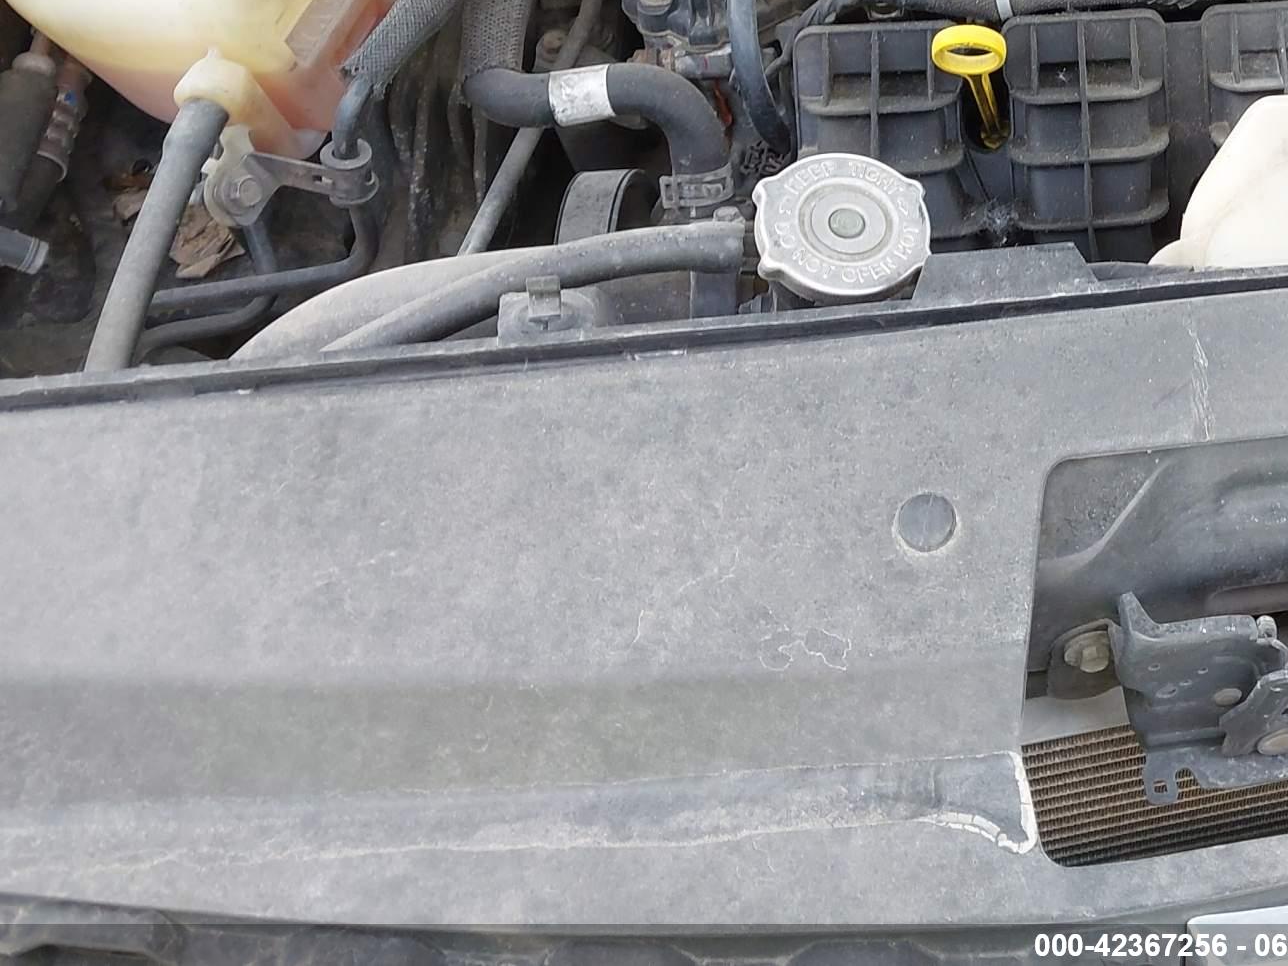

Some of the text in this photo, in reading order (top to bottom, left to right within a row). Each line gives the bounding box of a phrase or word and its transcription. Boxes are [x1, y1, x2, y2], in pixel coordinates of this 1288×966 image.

[784, 160, 905, 195] KEEP TIGHT
[774, 221, 920, 284] DO NOT OPEN HOT
